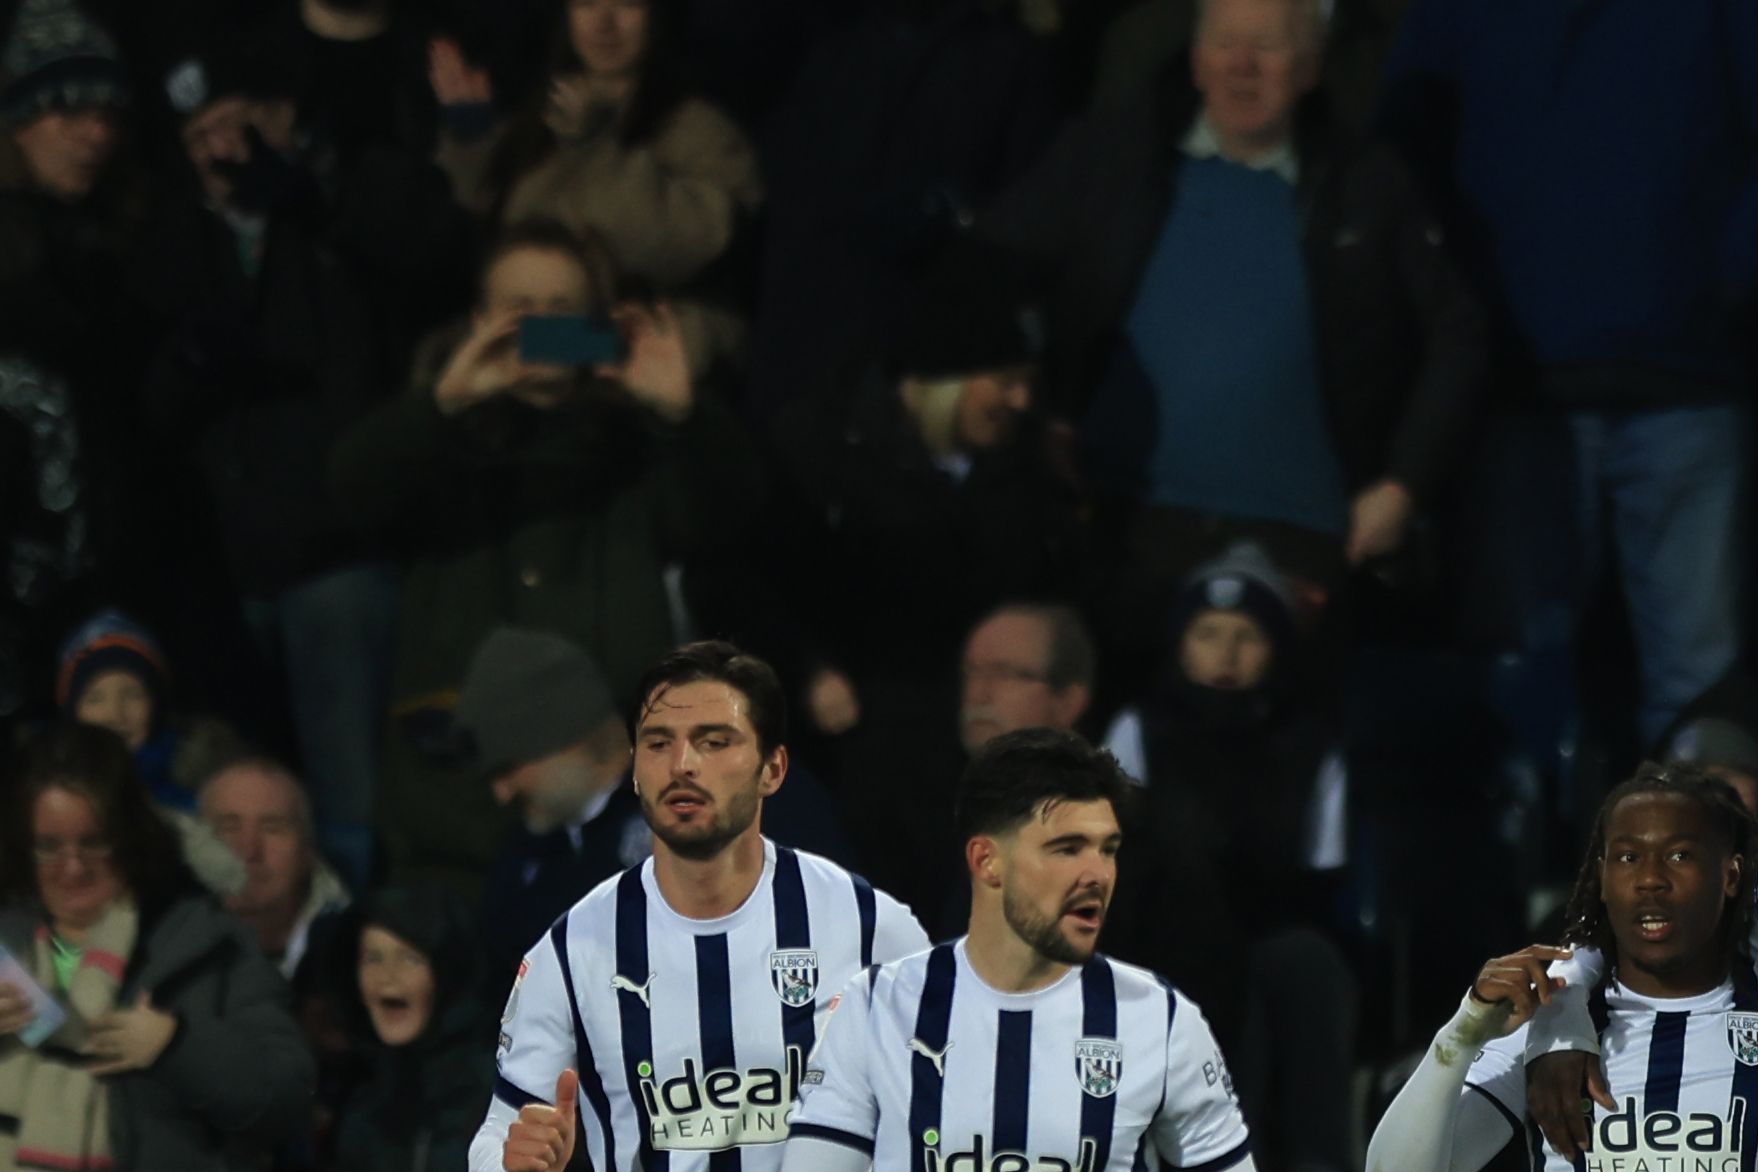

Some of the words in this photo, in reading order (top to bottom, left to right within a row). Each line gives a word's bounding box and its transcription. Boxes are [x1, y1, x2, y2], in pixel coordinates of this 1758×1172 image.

[773, 958, 815, 968] ALBION
[1078, 1047, 1120, 1059] ALBION
[637, 1046, 801, 1117] ideal
[1581, 1095, 1747, 1153] ideal
